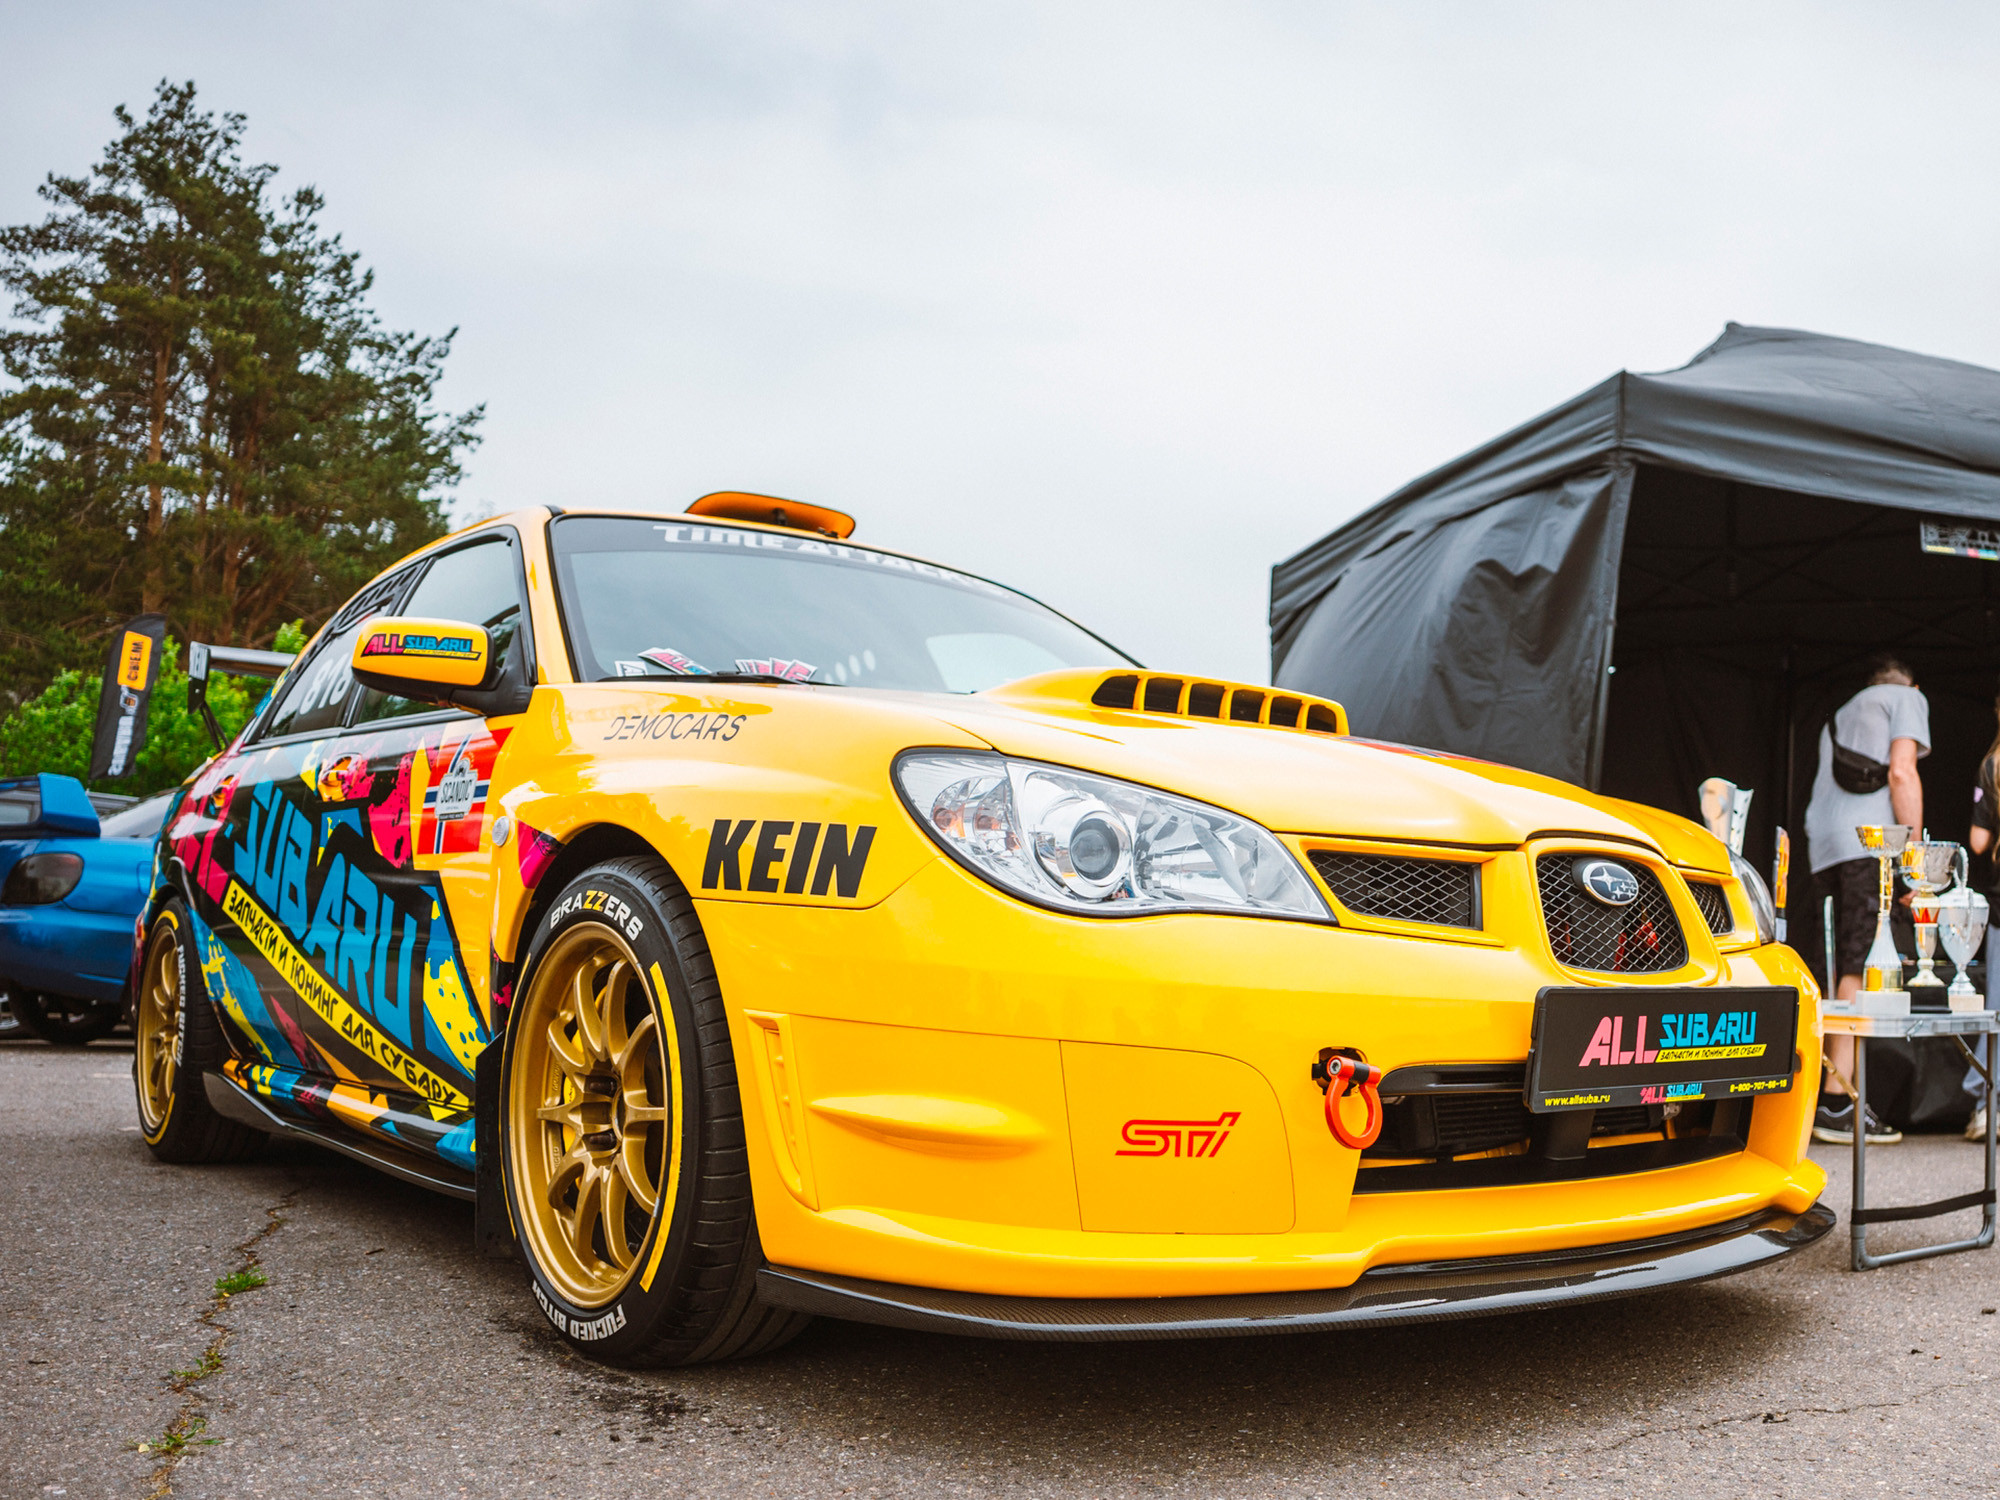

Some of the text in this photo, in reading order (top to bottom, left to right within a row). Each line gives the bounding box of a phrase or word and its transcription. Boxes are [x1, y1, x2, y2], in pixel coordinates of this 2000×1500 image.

[653, 525, 790, 549] TIME
[362, 634, 404, 655] ALL
[405, 635, 473, 652] SUBARU
[603, 713, 747, 741] DEMOCARS
[440, 779, 473, 804] SCANDIC
[701, 819, 878, 899] KEIN
[234, 773, 417, 1051] SUBARU
[550, 889, 644, 942] BRAZZERS
[229, 889, 457, 1104] ЗАПЧАСТИ И ТЮНИНГ ДЛЯ СУБАРУ
[1578, 1011, 1757, 1067] ALL SUBARU
[1544, 1094, 1611, 1107] www.allsuba.ru
[1666, 1083, 1703, 1097] SUBARU
[531, 1279, 627, 1341] FUCKED BITCH
